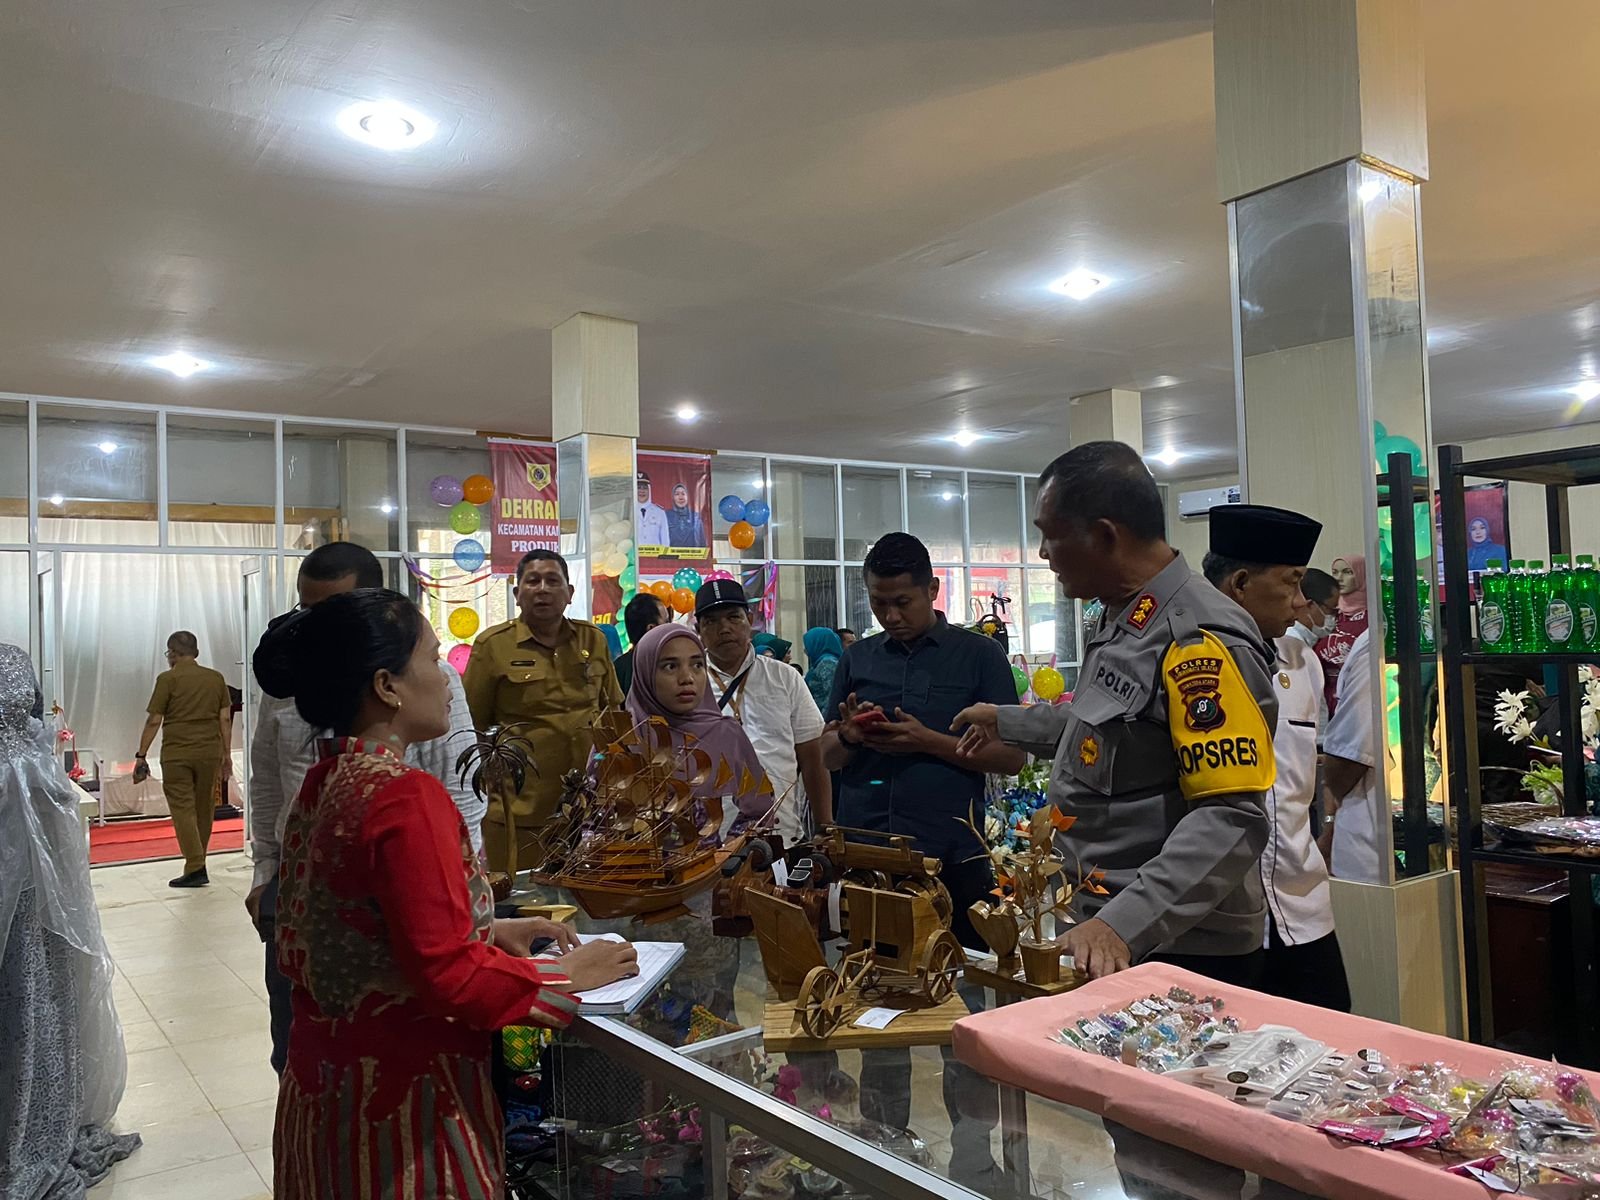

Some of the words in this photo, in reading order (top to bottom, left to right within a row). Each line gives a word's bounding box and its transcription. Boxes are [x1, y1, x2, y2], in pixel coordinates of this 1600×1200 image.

[497, 523, 544, 535] KECAMATAN
[1174, 659, 1217, 673] POLRES
[1095, 666, 1135, 700] POLRI
